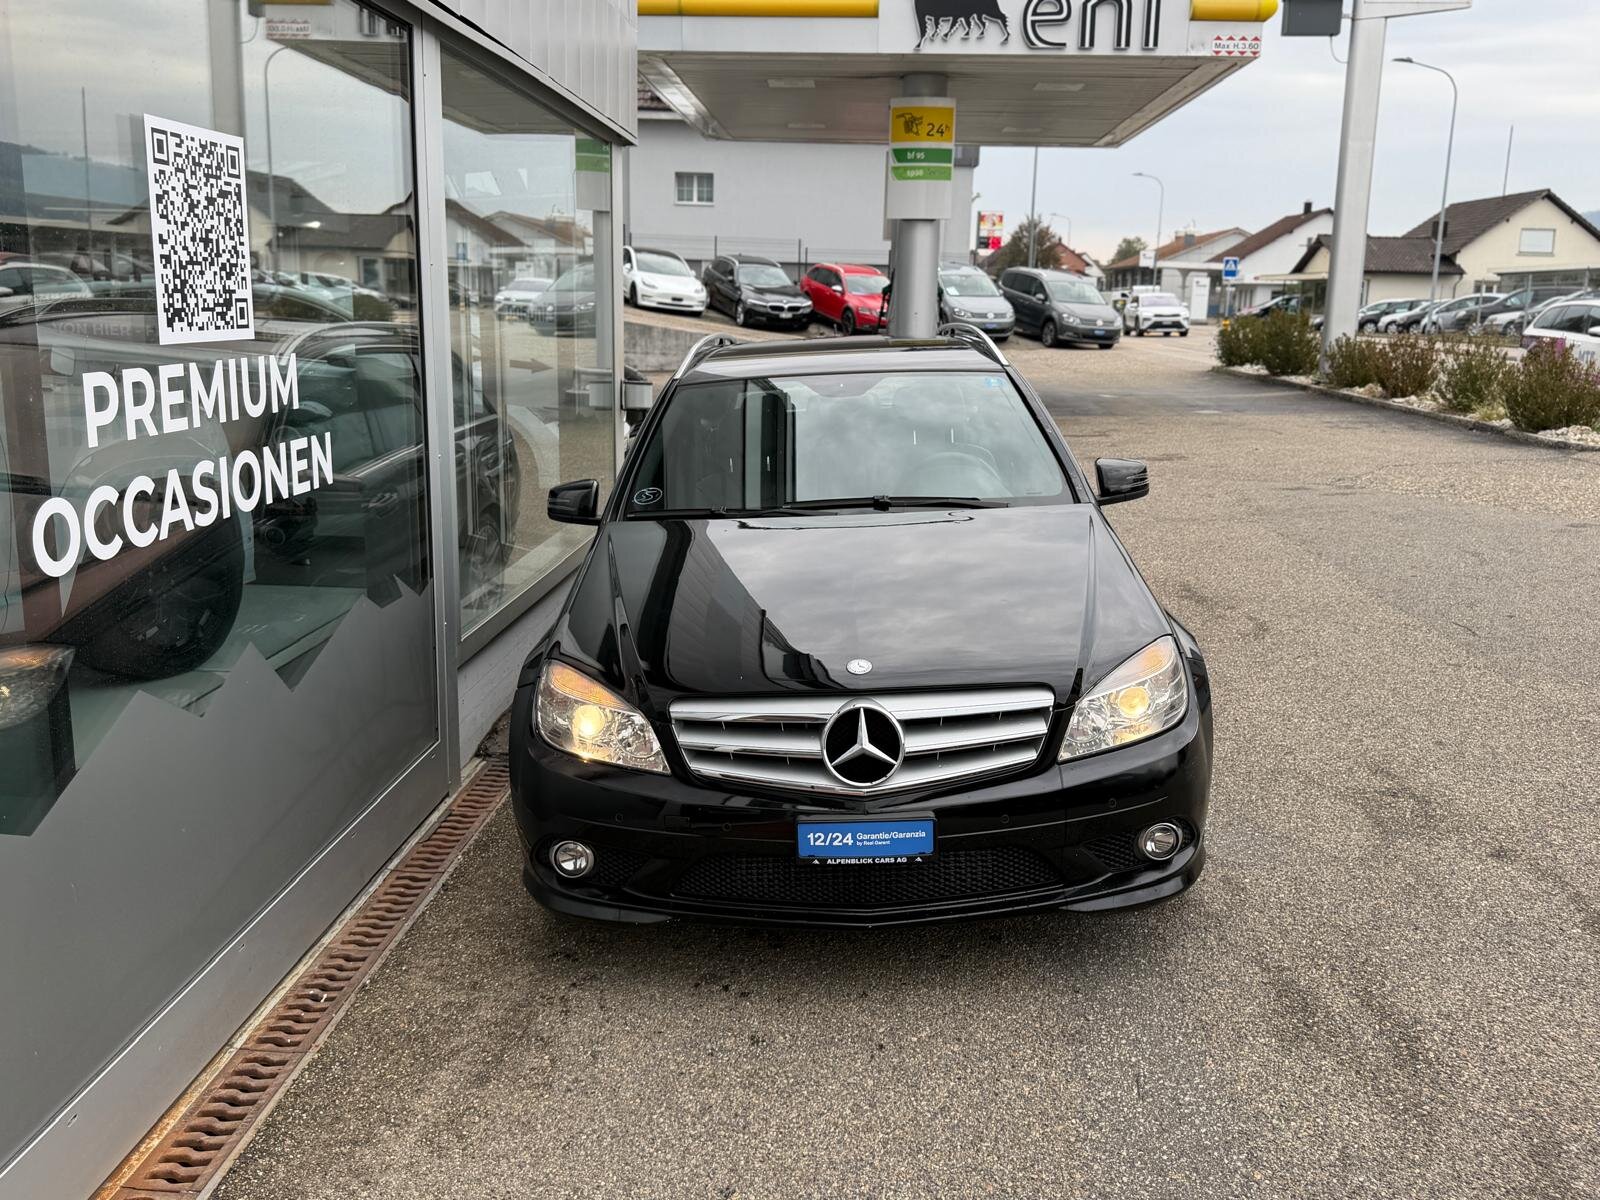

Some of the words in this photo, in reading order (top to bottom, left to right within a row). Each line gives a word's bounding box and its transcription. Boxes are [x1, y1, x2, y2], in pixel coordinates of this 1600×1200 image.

[1022, 0, 1162, 50] eni
[82, 353, 299, 448] PREMIUM
[32, 432, 334, 577] OCCASIONEN
[807, 832, 854, 846] 12/24
[856, 829, 926, 840] Garantie/Garanzia
[826, 857, 874, 865] ALPENBLICK
